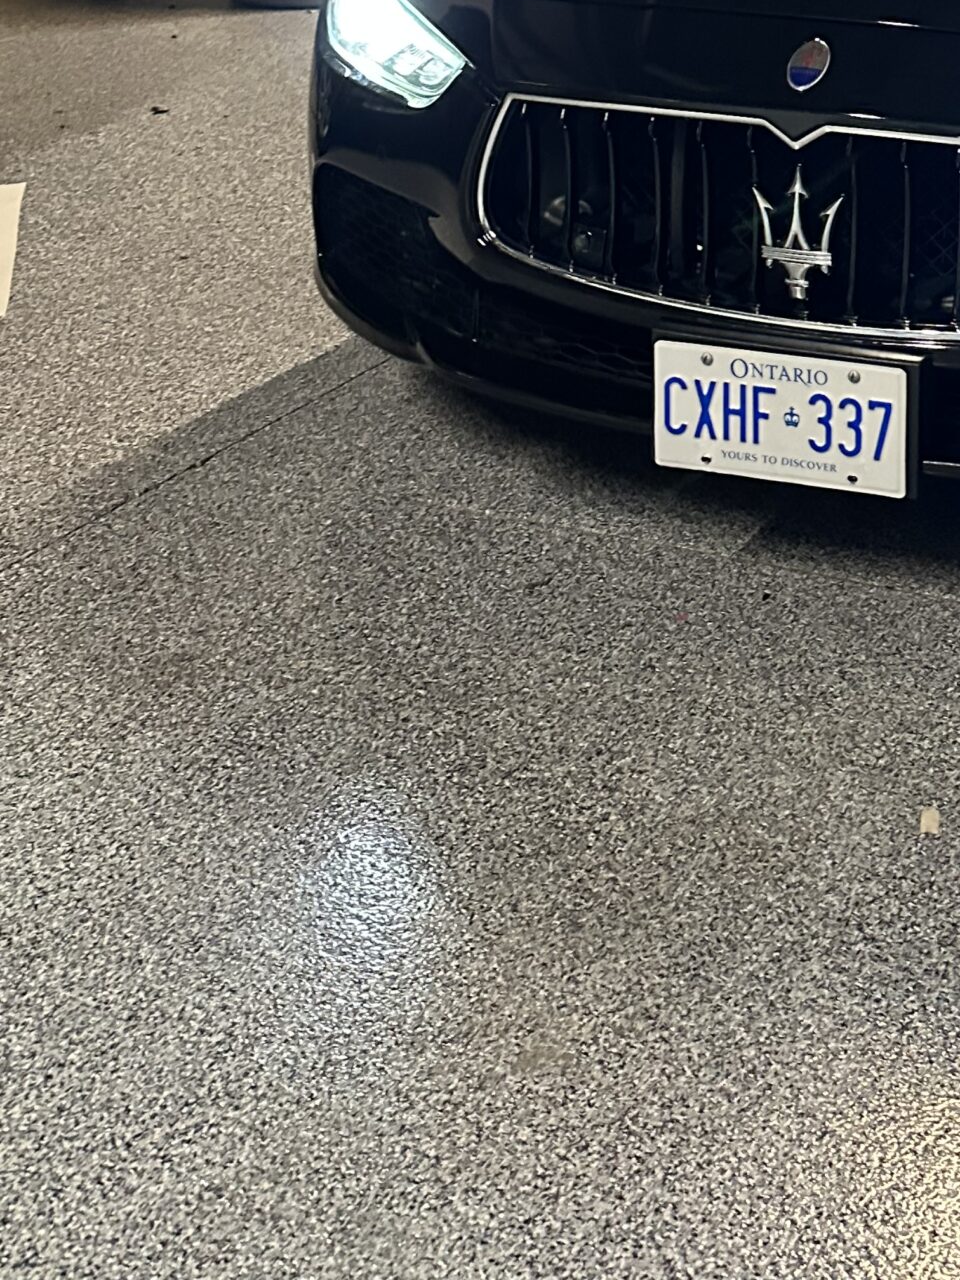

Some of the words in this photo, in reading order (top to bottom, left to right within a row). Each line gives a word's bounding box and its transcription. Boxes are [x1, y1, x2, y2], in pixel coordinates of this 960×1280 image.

[730, 358, 828, 386] ONTARIO
[664, 377, 777, 444] CXHF
[808, 393, 892, 461] 337
[721, 449, 758, 463] YOURS
[762, 454, 778, 465] TO
[781, 457, 838, 473] DISCOVER
